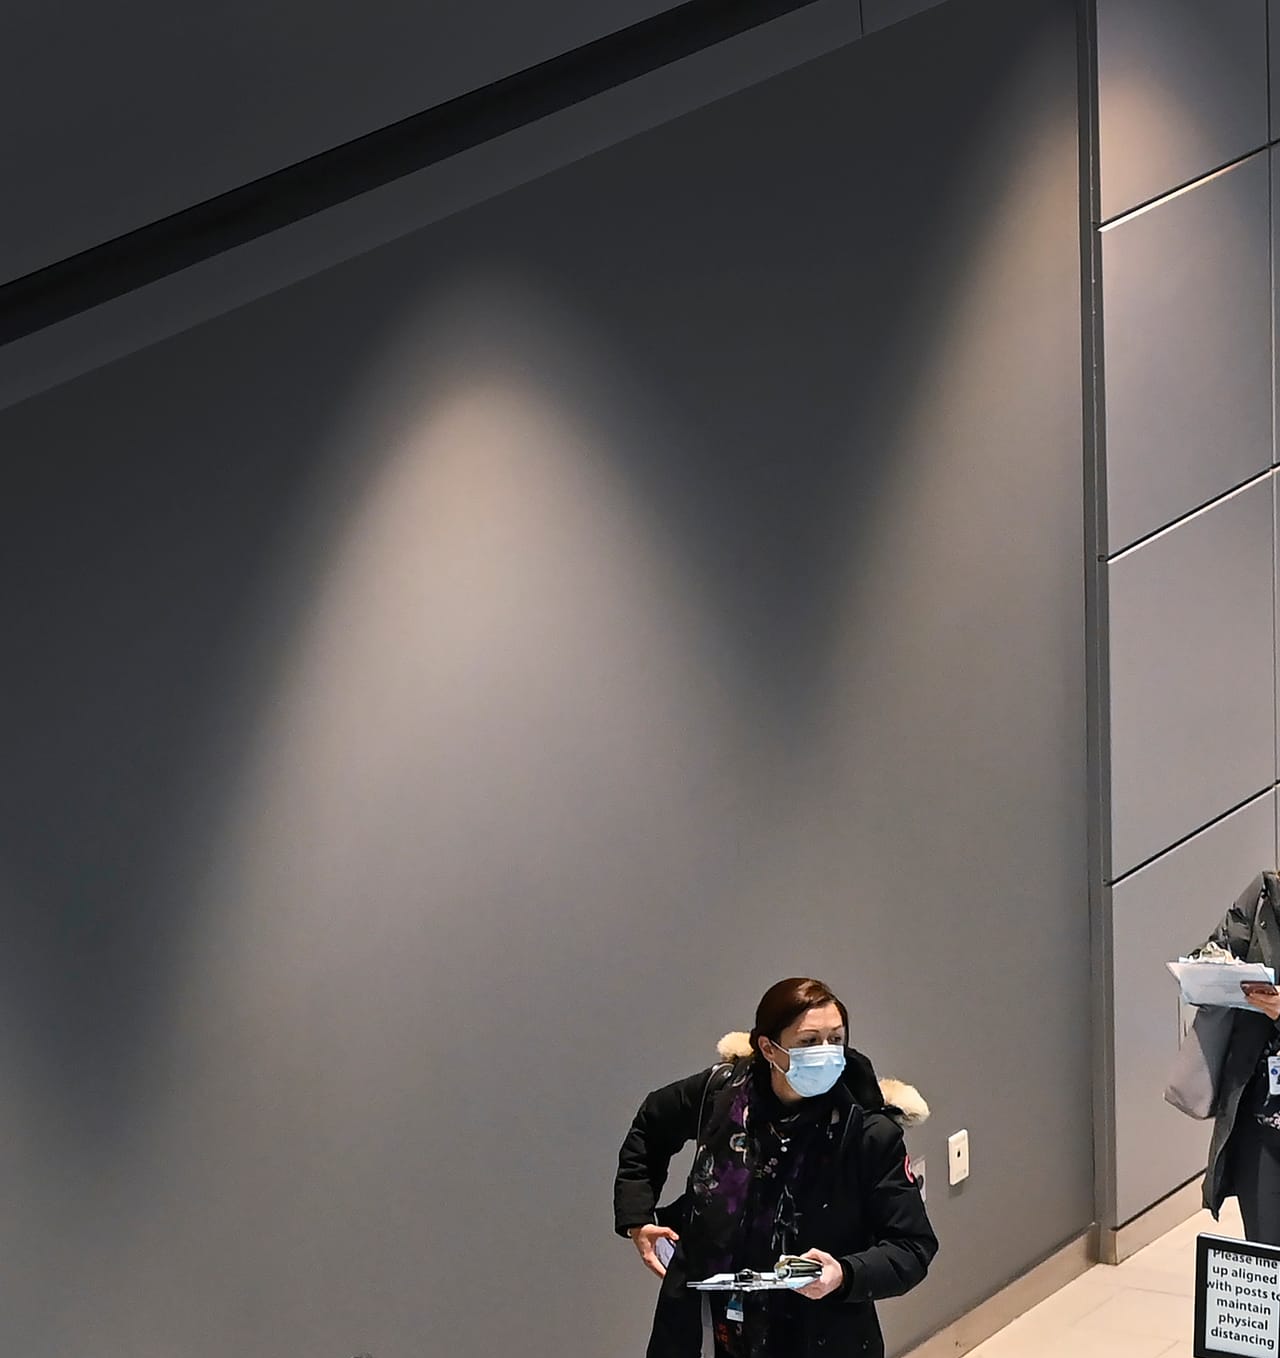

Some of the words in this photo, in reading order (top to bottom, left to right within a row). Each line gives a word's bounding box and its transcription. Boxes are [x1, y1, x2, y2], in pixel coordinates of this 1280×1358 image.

[1212, 1265, 1228, 1277] up
[1231, 1268, 1277, 1285] aligned
[1235, 1285, 1268, 1299] posts
[1217, 1298, 1271, 1315] maintain
[1218, 1312, 1268, 1331] physical
[1210, 1326, 1275, 1350] distancing
